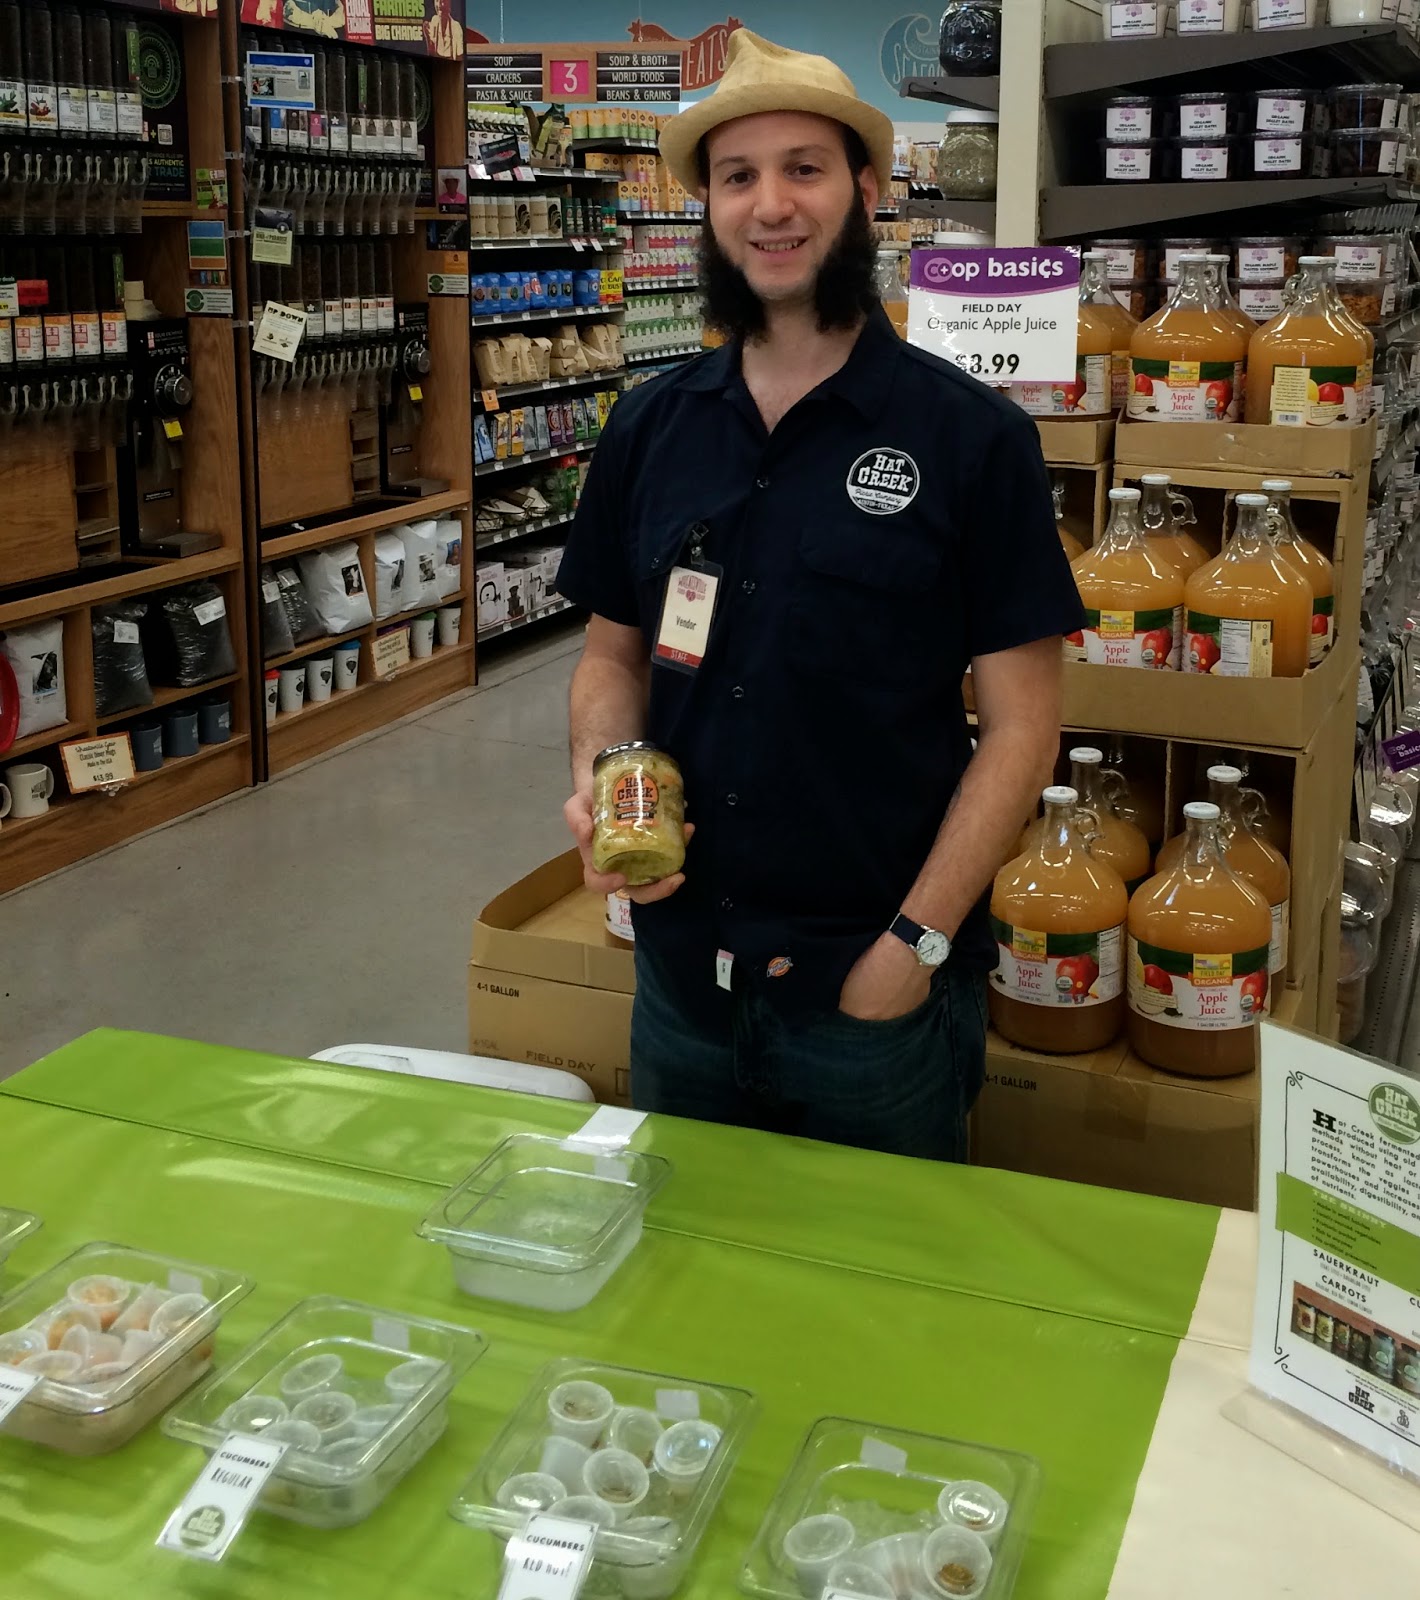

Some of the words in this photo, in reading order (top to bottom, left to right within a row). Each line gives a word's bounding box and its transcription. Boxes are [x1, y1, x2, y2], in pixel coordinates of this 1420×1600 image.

[375, 25, 391, 40] BIG
[391, 25, 423, 41] CHANGE
[494, 56, 514, 67] SOUP
[609, 56, 630, 66] SOUP
[632, 56, 639, 66] &
[641, 56, 668, 66] BROTH
[685, 28, 729, 87] EATS
[486, 73, 522, 84] CRACKERS
[563, 63, 578, 93] 3
[612, 72, 638, 82] WORLD
[640, 72, 665, 83] FOODS
[476, 90, 499, 101] PASTA
[500, 90, 507, 101] &
[508, 90, 533, 101] SAUCE
[606, 90, 631, 101] BEANS
[634, 90, 640, 101] &
[644, 90, 672, 101] GRAINS
[154, 159, 185, 167] AUTHENTIC
[155, 167, 185, 178] TRADE
[962, 304, 994, 313] FIELD
[997, 304, 1023, 313] DAY
[927, 317, 979, 334] Oganic
[982, 317, 1022, 334] Apple
[1025, 317, 1058, 334] Juice
[1021, 385, 1042, 395] Apple
[1171, 392, 1195, 402] Apple
[1022, 394, 1041, 403] Juice
[1172, 401, 1193, 411] Juice
[872, 454, 906, 473] HAT
[857, 466, 914, 493] CREEK
[676, 615, 697, 631] Vendor
[671, 649, 688, 662] STAFF
[1103, 644, 1131, 655] Apple
[1105, 655, 1128, 665] Juice
[1398, 744, 1420, 757] basic
[1016, 965, 1043, 979] Apple
[477, 982, 488, 991] 4-1
[490, 984, 520, 998] GALLON
[1017, 977, 1041, 989] Juice
[1197, 992, 1228, 1005] Apple
[1199, 1004, 1226, 1016] Juice
[526, 1050, 564, 1066] FIELD
[568, 1059, 596, 1072] DAY
[1000, 1075, 1037, 1091] GALLON
[1384, 1087, 1409, 1108] HAT
[1375, 1097, 1419, 1128] CREEK
[1351, 1124, 1374, 1140] Creek
[1312, 1127, 1343, 1145] methods
[1350, 1144, 1378, 1159] without
[1384, 1157, 1402, 1171] heat
[1338, 1129, 1375, 1149] produced
[1378, 1147, 1399, 1161] using
[1403, 1157, 1416, 1168] old
[1311, 1145, 1351, 1168] transforms
[1359, 1167, 1371, 1177] the
[1379, 1176, 1410, 1195] veggies
[1352, 1153, 1376, 1169] known
[1385, 1170, 1394, 1178] as
[1311, 1156, 1360, 1182] powerhouses
[1364, 1180, 1379, 1191] and
[1383, 1188, 1420, 1210] increases
[1311, 1174, 1319, 1182] of
[1322, 1180, 1357, 1200] nutrients.
[1311, 1165, 1357, 1192] availability,
[1360, 1187, 1409, 1217] digestibility,
[1313, 1248, 1380, 1288] SAUERKRAUT
[1321, 1275, 1367, 1303] CARROTS
[1355, 1385, 1370, 1401] HAT
[1348, 1391, 1375, 1414] CREEK
[220, 1451, 271, 1469] CUCUMBERS
[211, 1467, 253, 1489] REGULAR
[526, 1534, 585, 1552] CUCUMBERS
